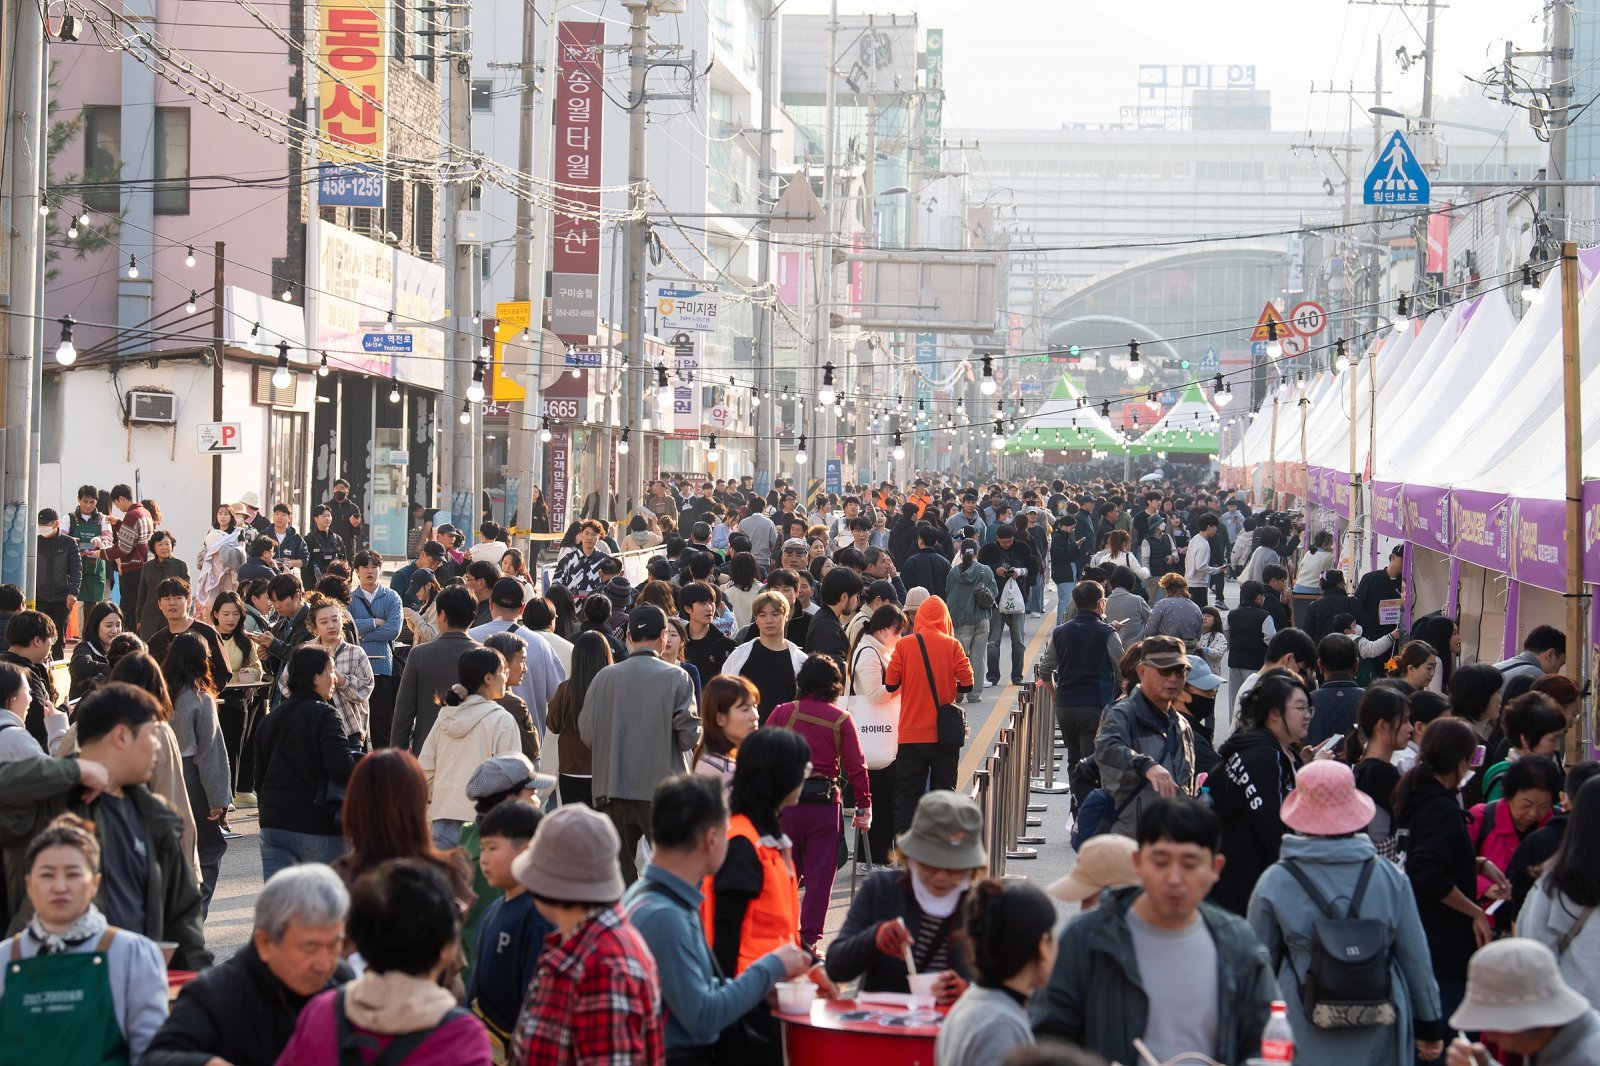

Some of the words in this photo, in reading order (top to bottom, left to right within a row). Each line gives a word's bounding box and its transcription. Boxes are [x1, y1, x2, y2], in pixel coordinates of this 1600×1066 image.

[323, 9, 381, 145] 동산
[1138, 65, 1256, 98] 구미역
[566, 69, 591, 179] 송월타월
[322, 177, 381, 197] 458-1255
[1373, 191, 1419, 202] 횡단보도
[559, 288, 593, 299] 구미송월
[555, 308, 595, 318] 054-452-4665
[676, 300, 717, 317] 구미지점
[1297, 311, 1319, 329] 40
[387, 335, 411, 344] 역전로
[713, 408, 729, 426] 약
[222, 425, 236, 446] P
[553, 450, 565, 543] 고객만족우수대리
[1005, 601, 1016, 610] 24
[861, 725, 893, 734] 하이비오
[496, 931, 511, 954] P
